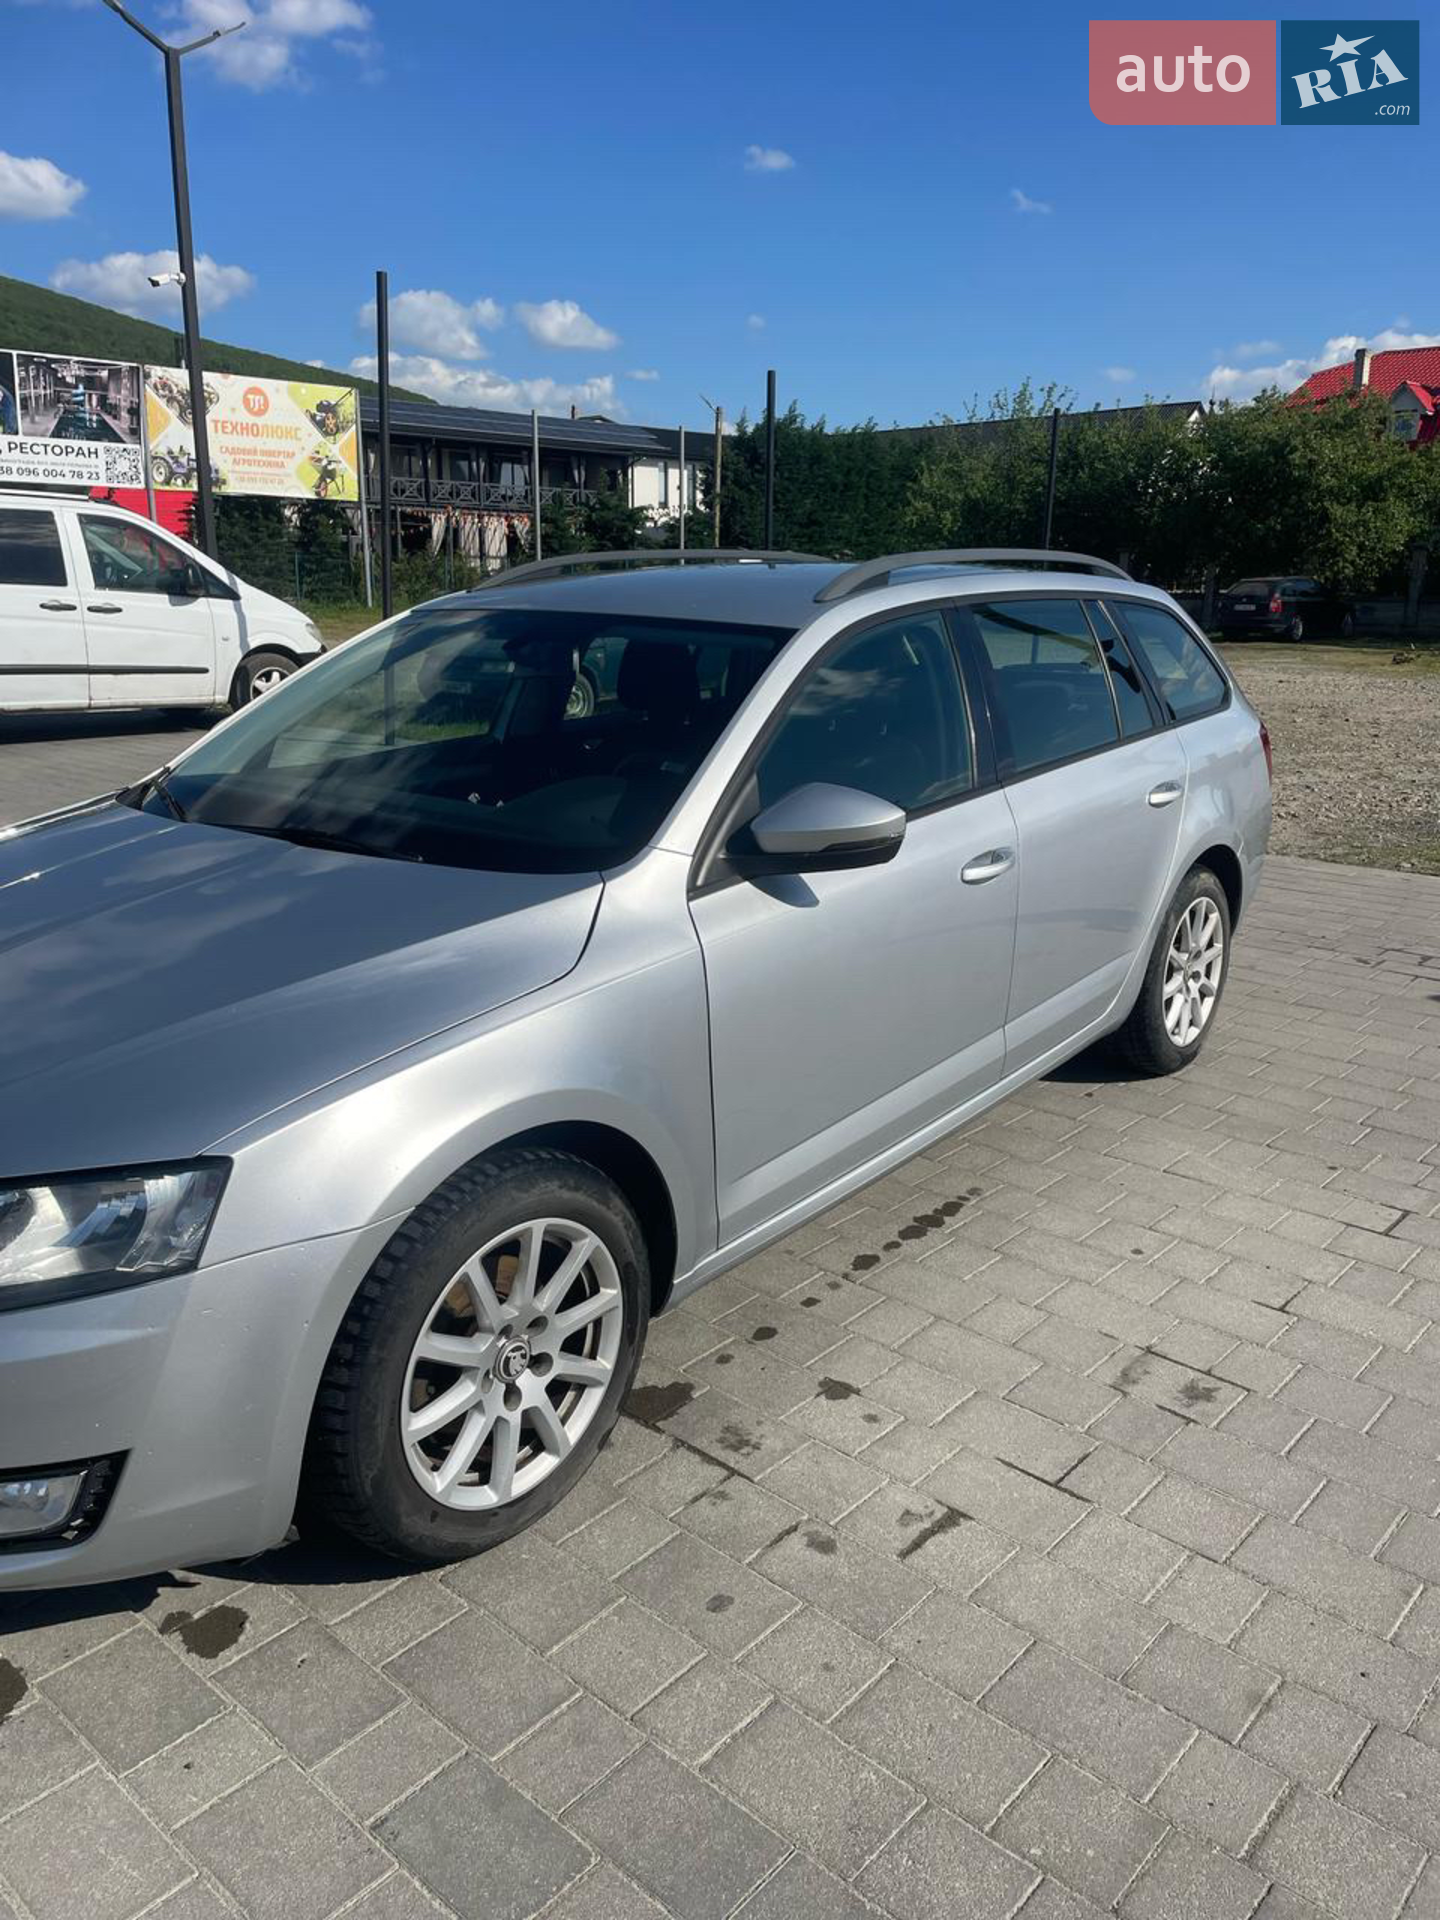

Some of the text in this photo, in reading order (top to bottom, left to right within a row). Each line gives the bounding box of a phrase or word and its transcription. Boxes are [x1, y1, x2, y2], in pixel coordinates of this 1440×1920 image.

[212, 419, 302, 441] ТЕХНОЛЮКС
[7, 441, 98, 458] РЕСТОРАН
[16, 466, 40, 477] 096
[42, 467, 66, 478] 004
[69, 470, 84, 480] 78
[87, 471, 100, 480] 23
